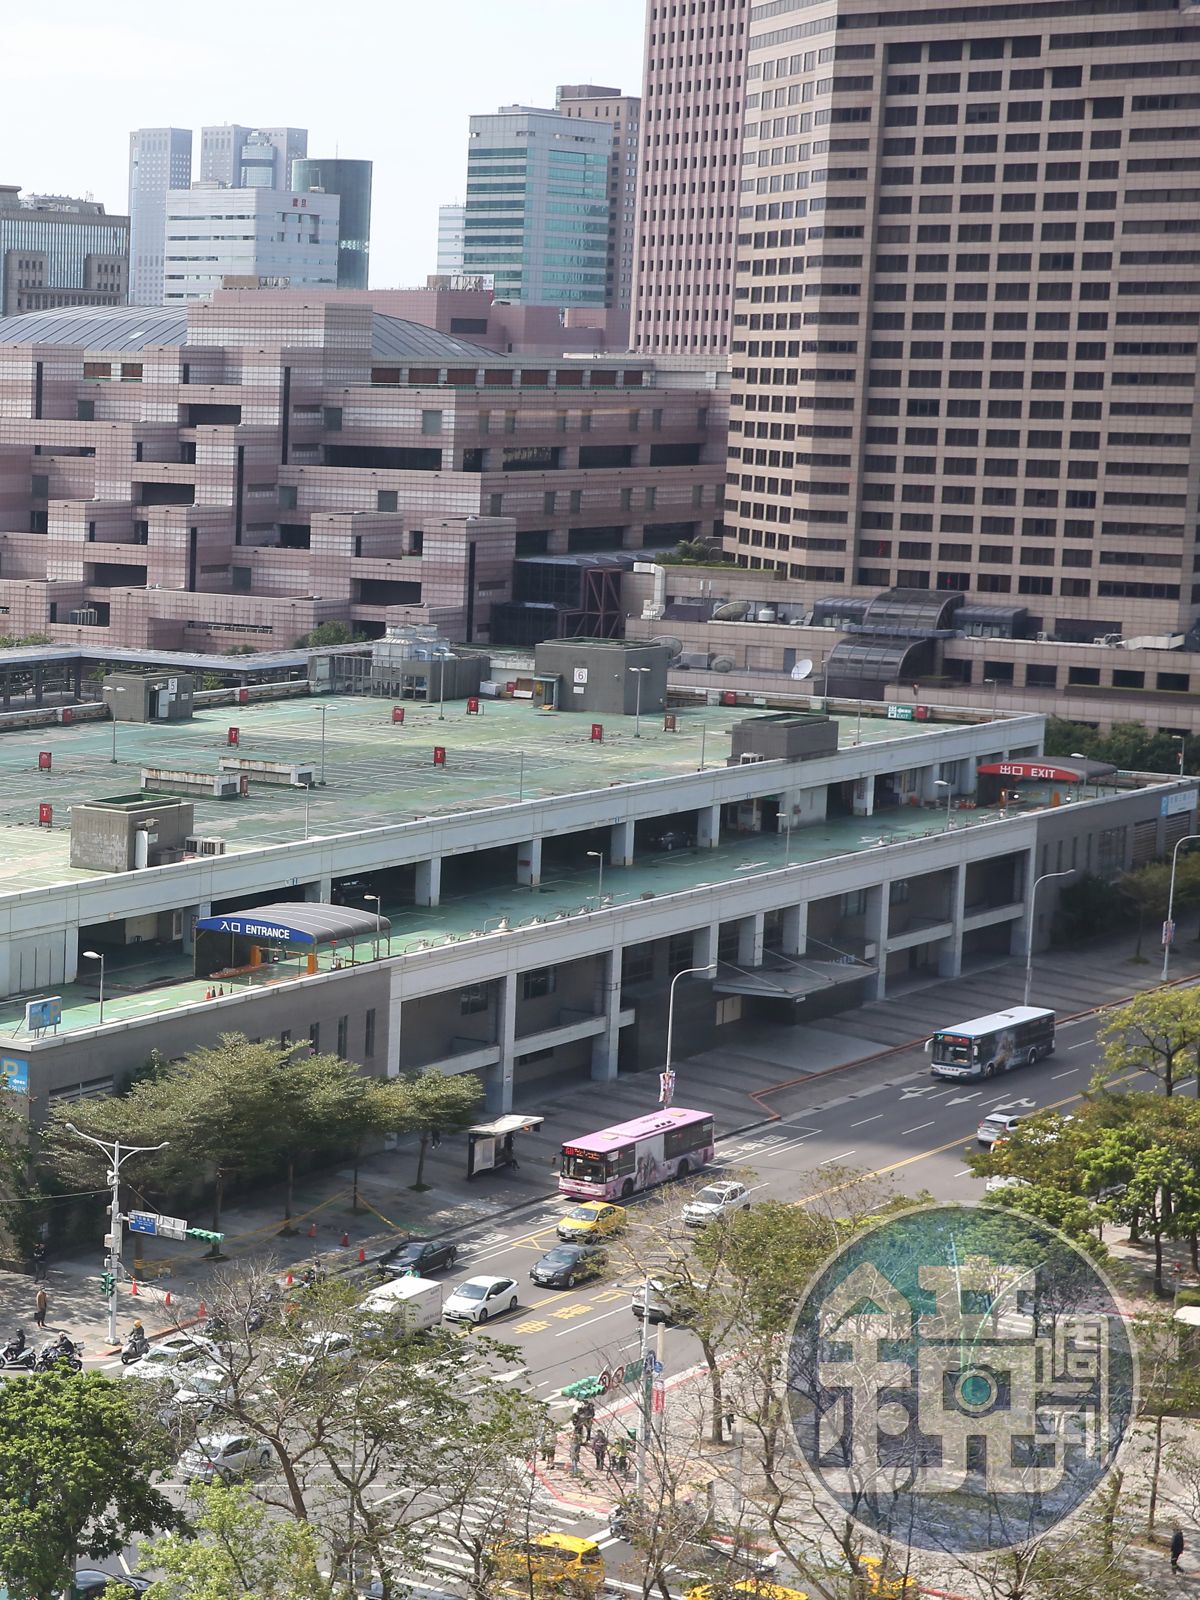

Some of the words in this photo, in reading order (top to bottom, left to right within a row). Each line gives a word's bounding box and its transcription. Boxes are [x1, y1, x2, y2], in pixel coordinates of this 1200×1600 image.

[999, 765, 1023, 776] 出口
[1031, 768, 1056, 779] EXIT
[220, 921, 241, 933] 入口
[245, 924, 290, 940] ENTRANCE
